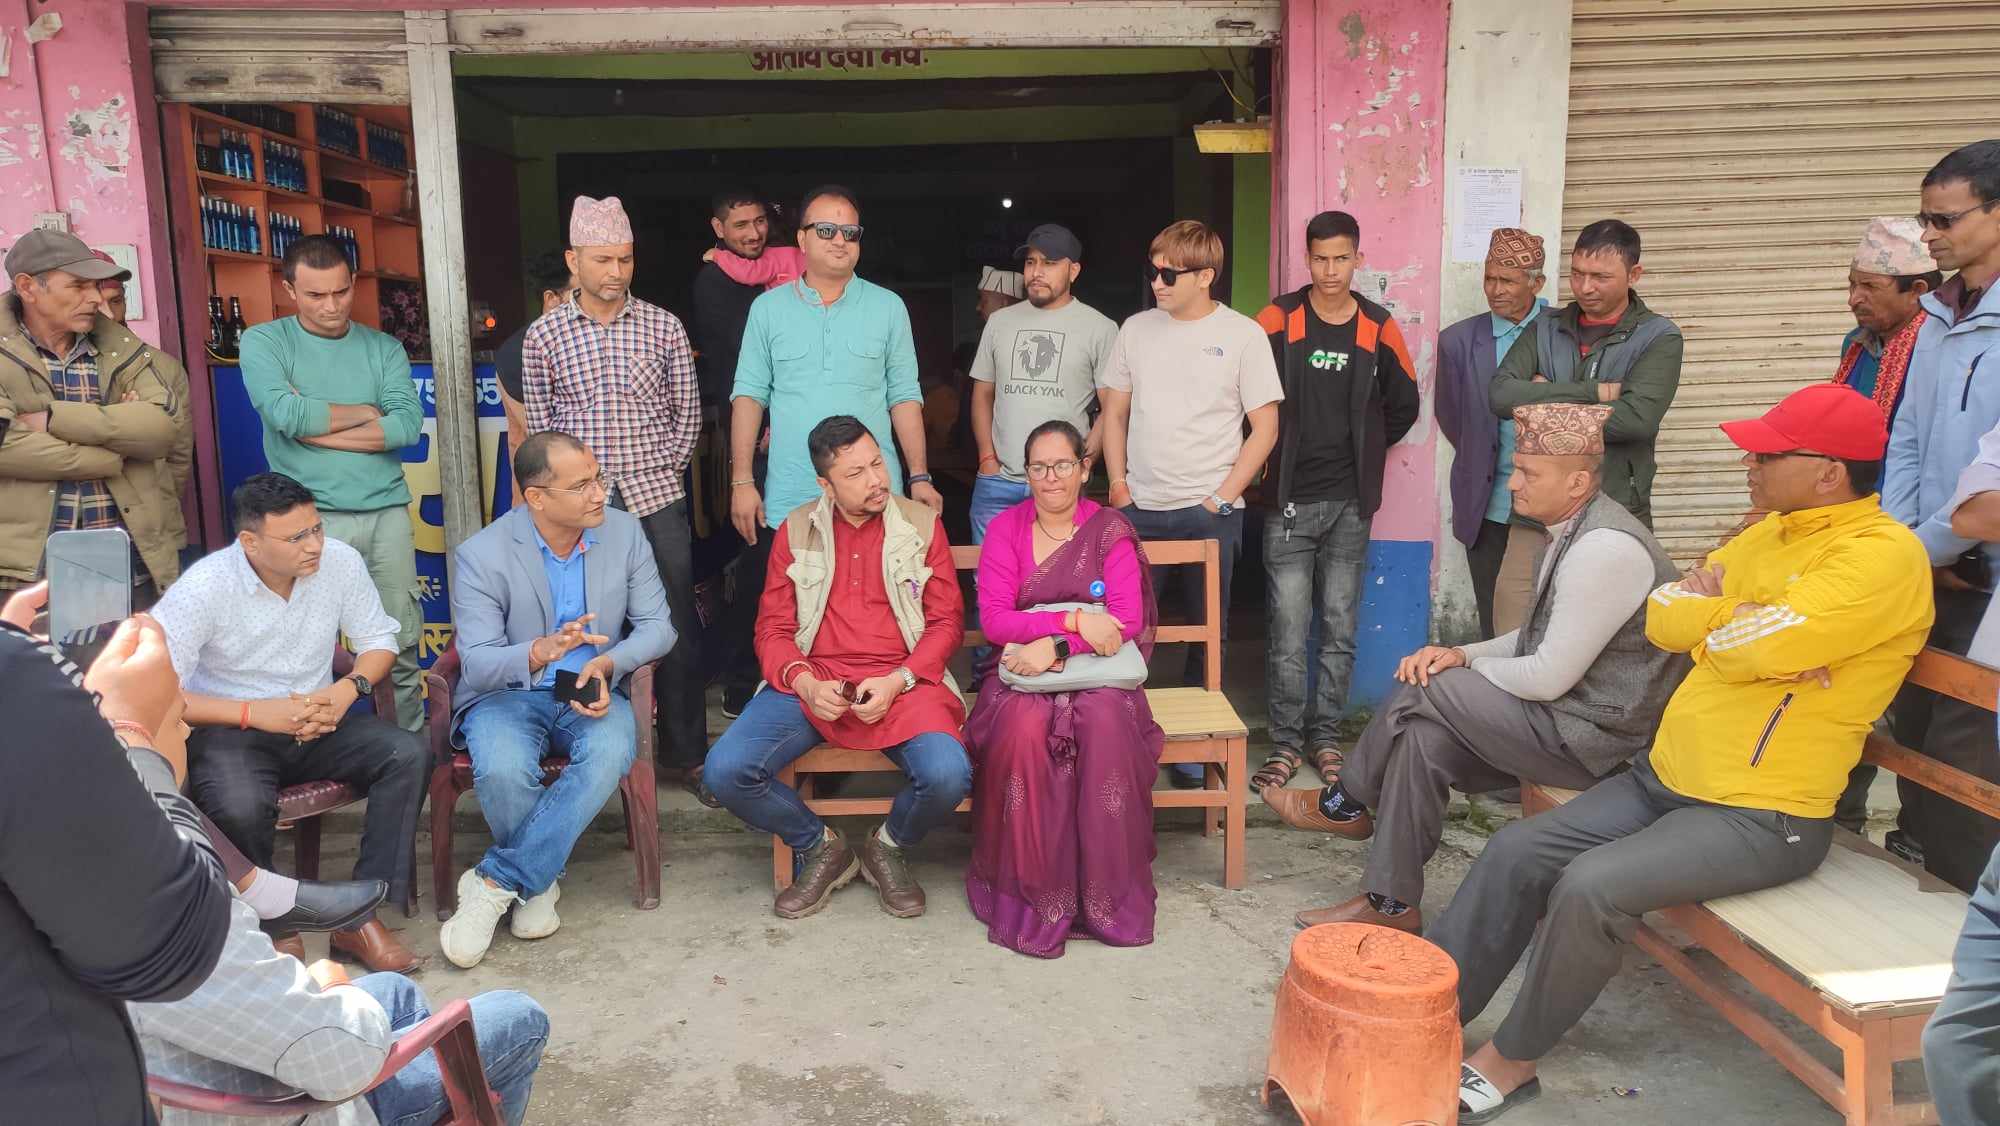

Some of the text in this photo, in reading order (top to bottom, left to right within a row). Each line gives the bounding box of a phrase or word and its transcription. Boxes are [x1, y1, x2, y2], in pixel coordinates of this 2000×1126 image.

[1310, 350, 1349, 371] OFF
[1004, 384, 1065, 398] BLACK YAK
